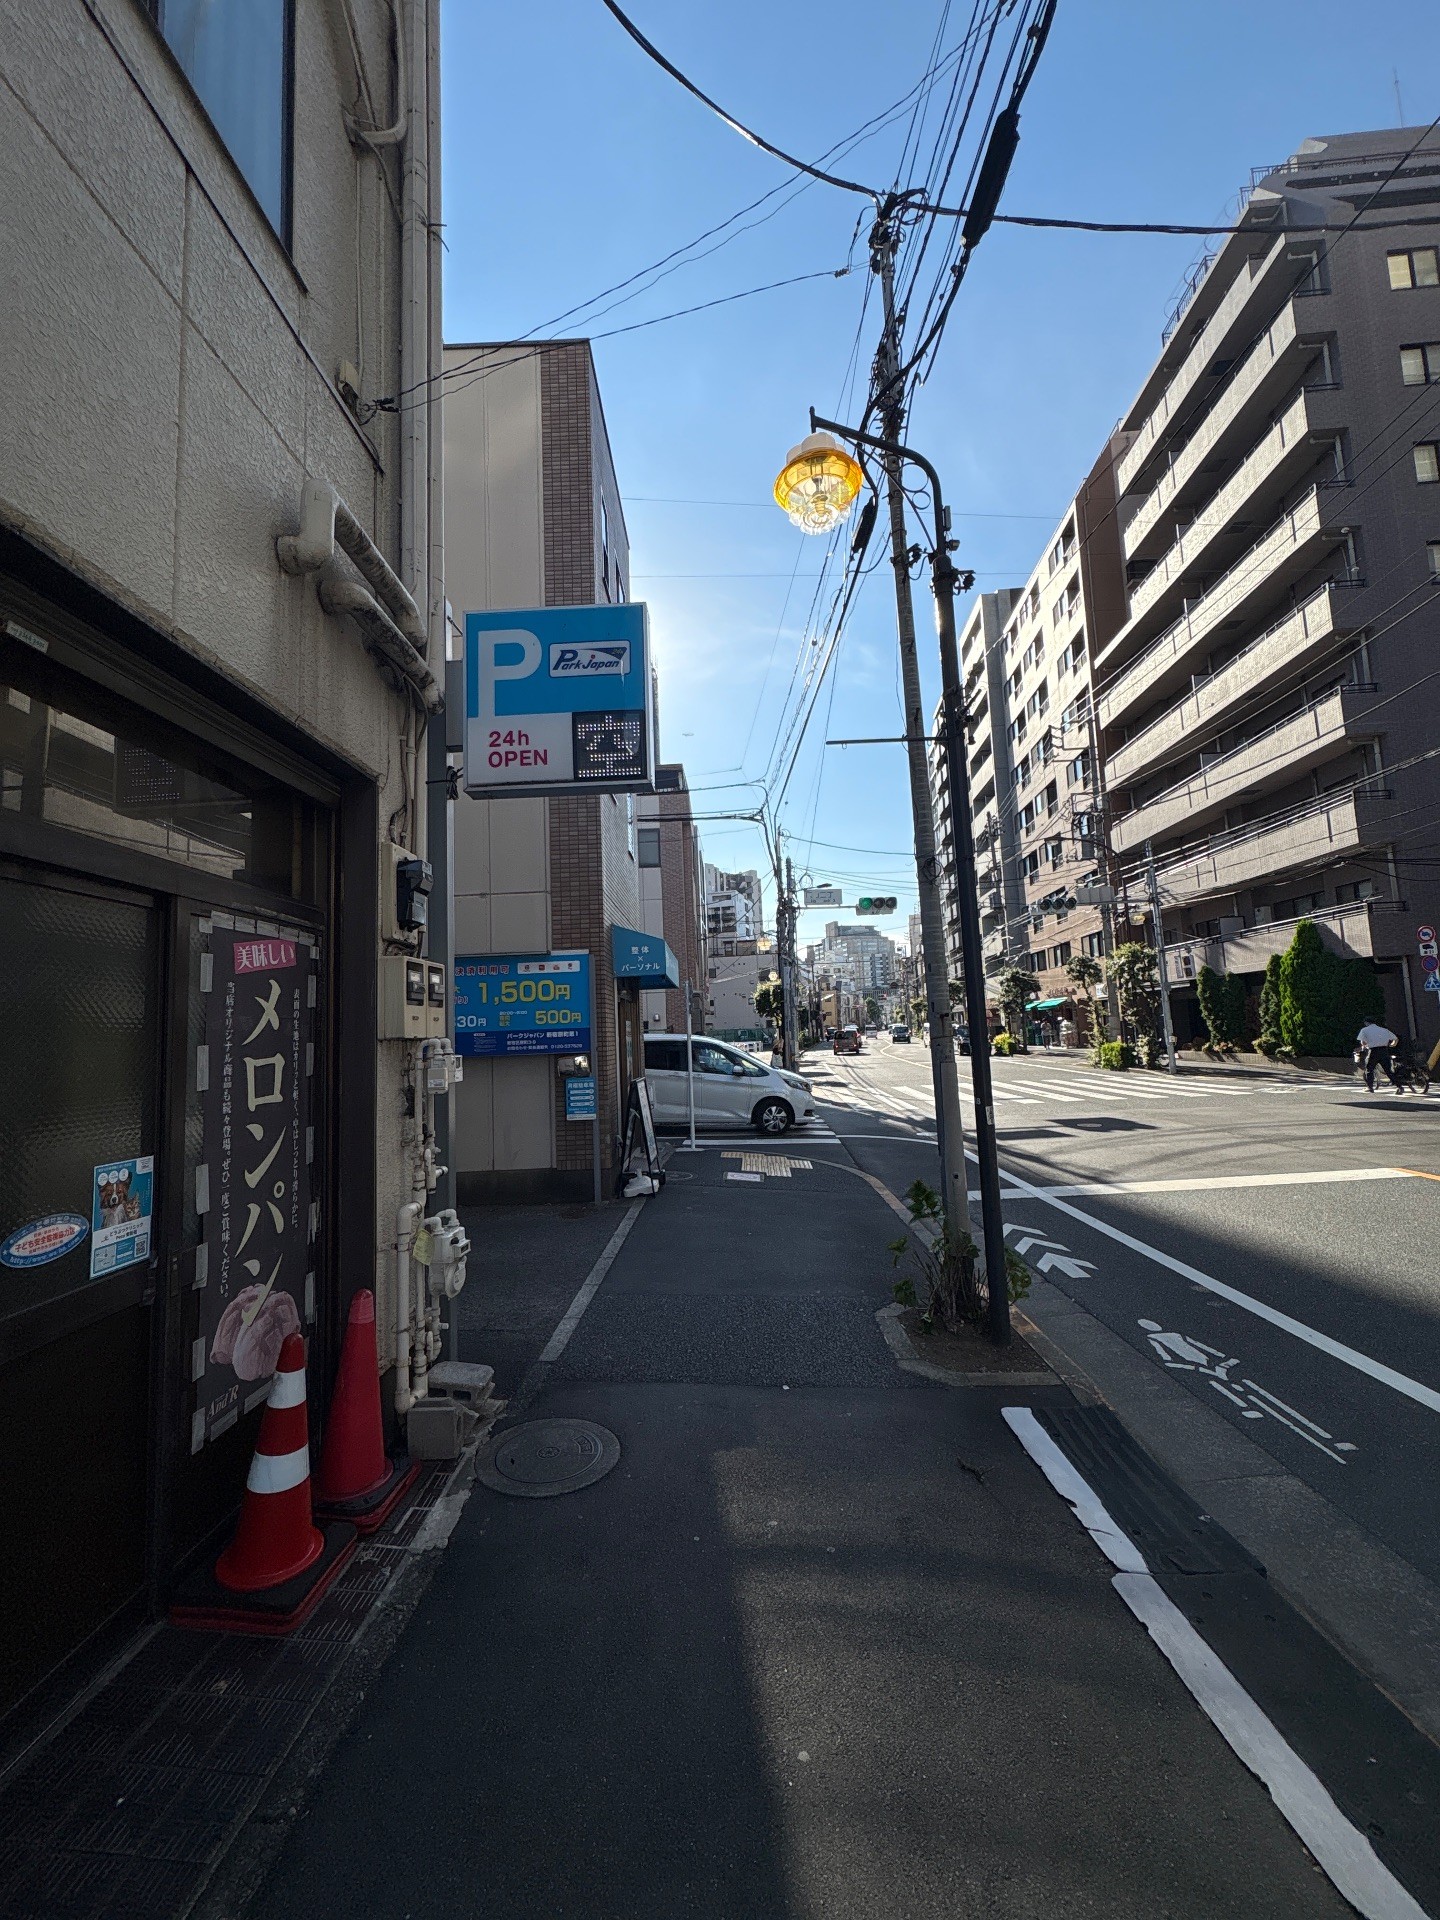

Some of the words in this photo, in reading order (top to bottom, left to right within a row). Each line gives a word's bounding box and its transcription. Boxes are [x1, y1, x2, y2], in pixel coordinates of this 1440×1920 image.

[582, 655, 619, 671] Japan
[478, 629, 542, 718] P
[488, 730, 529, 748] 24h
[577, 715, 642, 778] 空
[488, 749, 548, 768] OPEN
[236, 943, 296, 971] 美味しい
[631, 945, 649, 955] 整体
[621, 962, 661, 972] パーソナル
[478, 979, 571, 1006] 1,500円
[535, 1009, 582, 1026] 500円
[235, 979, 287, 1327] メロンパン
